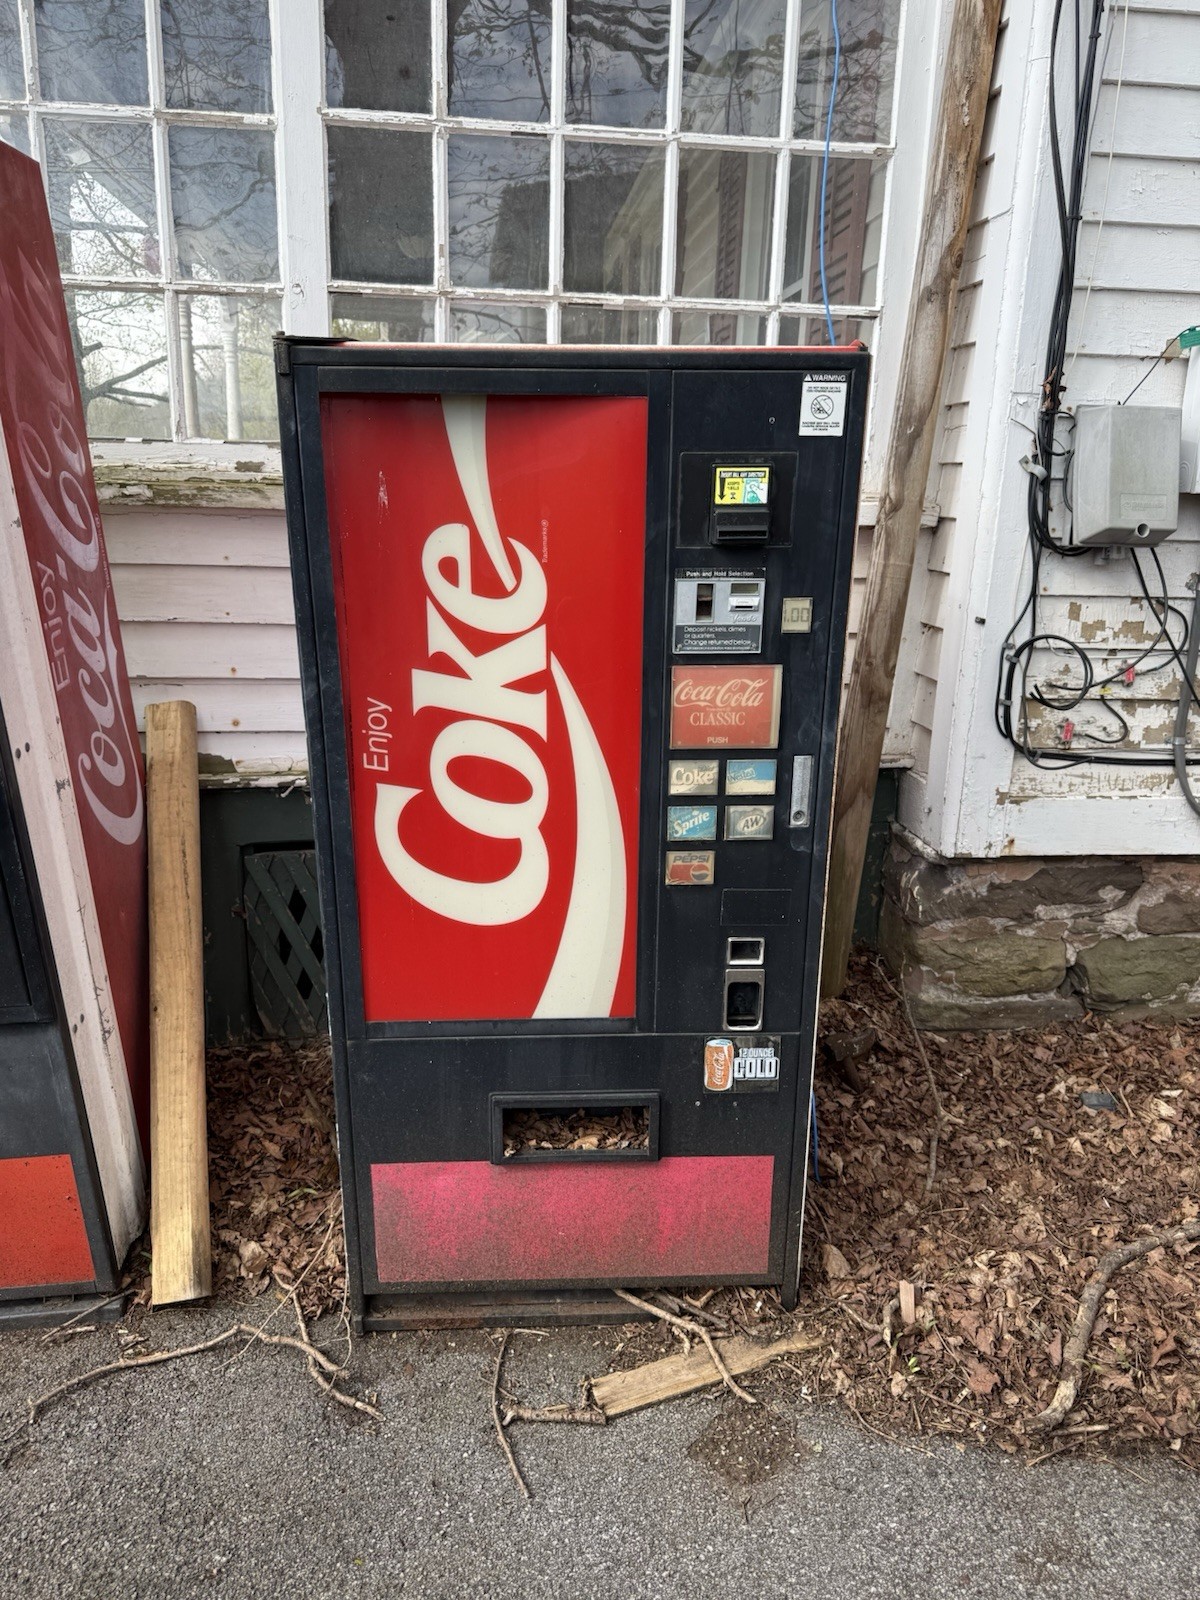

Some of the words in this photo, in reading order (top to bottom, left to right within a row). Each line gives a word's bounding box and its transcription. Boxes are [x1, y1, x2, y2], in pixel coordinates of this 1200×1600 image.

[812, 374, 846, 382] WARNING
[0, 246, 143, 846] Coca-Cola
[37, 560, 67, 692] Enjoy
[684, 639, 708, 647] Change
[374, 523, 551, 927] Coke
[690, 711, 746, 726] CLASSIC
[362, 697, 393, 774] Enjoy
[707, 736, 729, 744] PUSH
[672, 767, 714, 785] Coke
[673, 810, 710, 837] Sprite
[673, 853, 711, 863] PEPSI
[738, 1047, 748, 1058] 12
[748, 1047, 775, 1058] OUNCE
[734, 1057, 778, 1080] COLD
